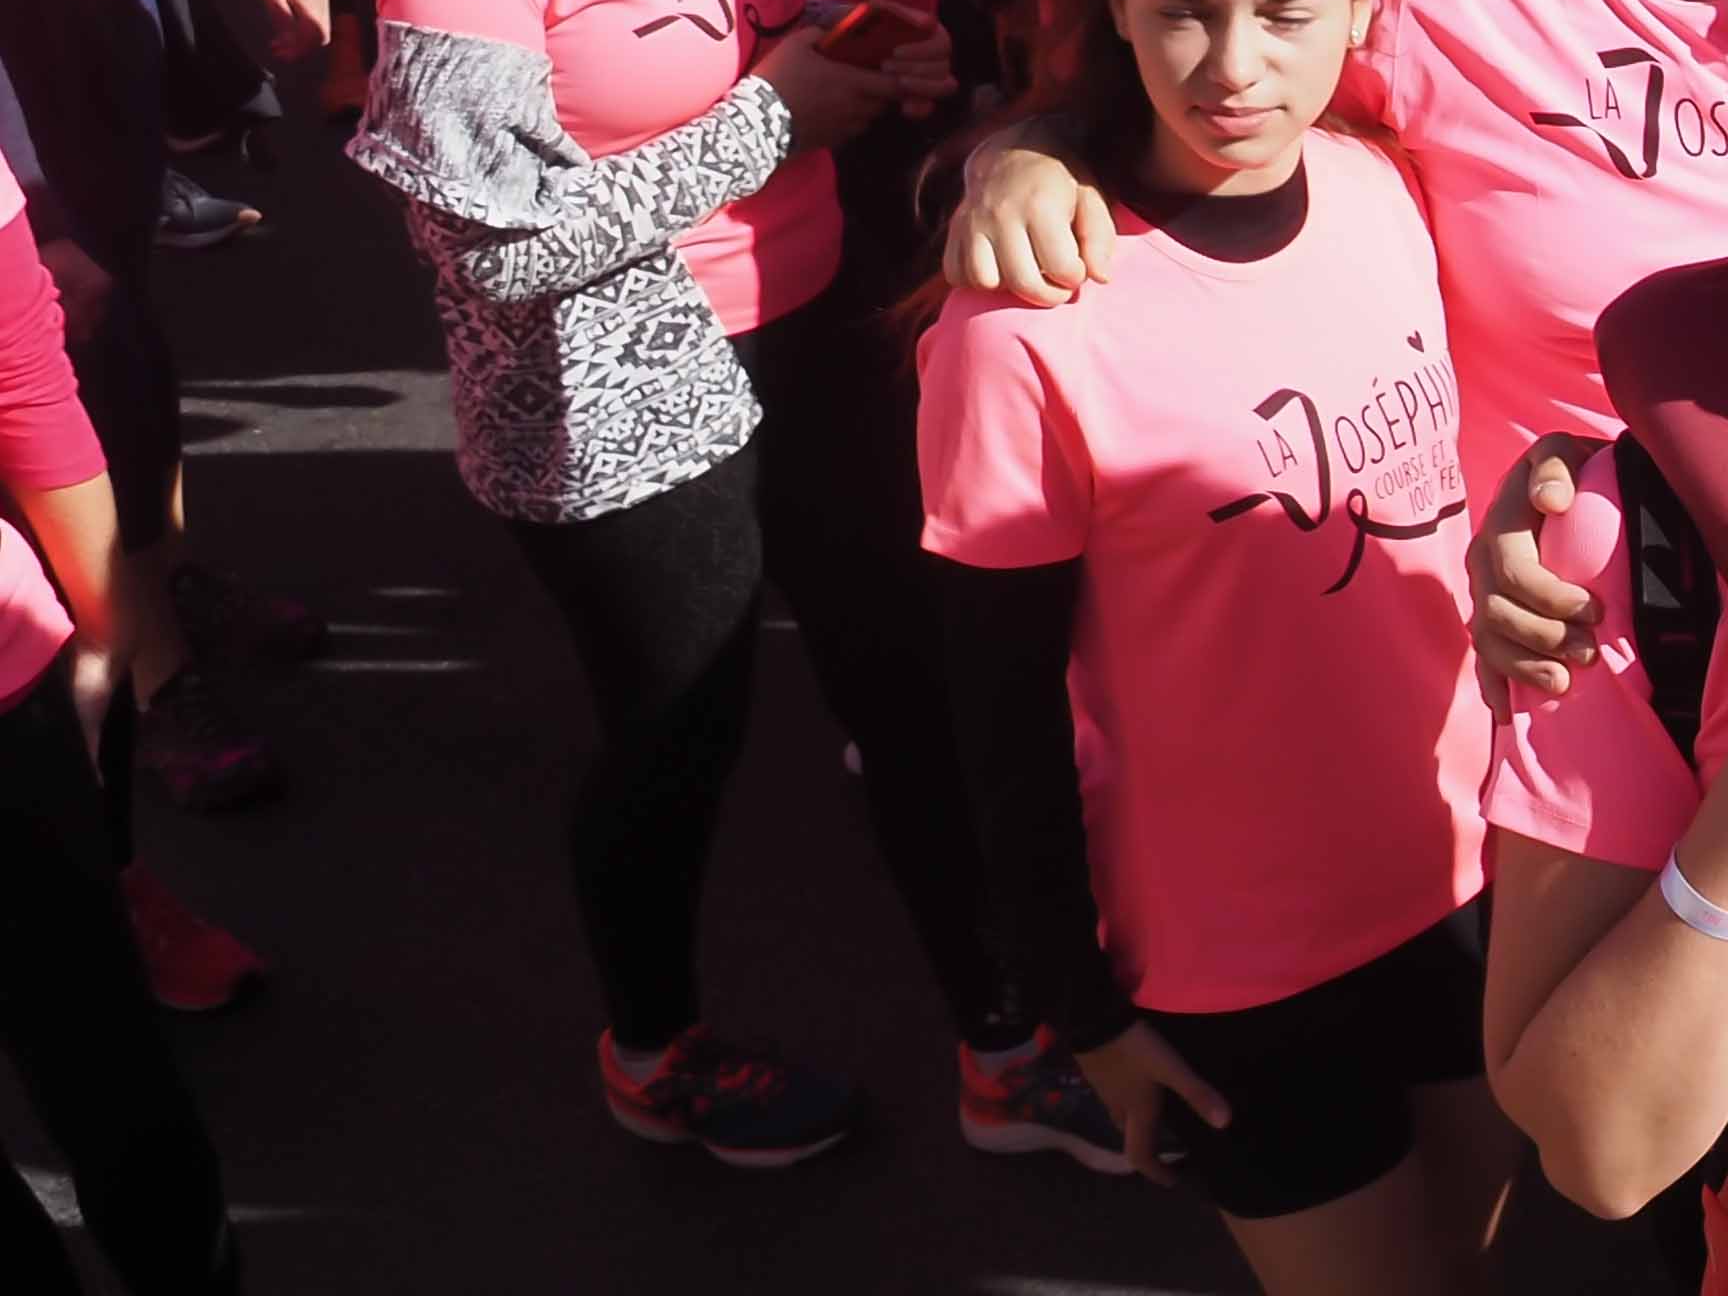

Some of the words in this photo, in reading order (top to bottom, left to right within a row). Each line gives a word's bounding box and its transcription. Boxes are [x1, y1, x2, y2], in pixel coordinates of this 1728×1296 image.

[1585, 76, 1622, 121] LA
[1256, 428, 1299, 478] LA
[1374, 453, 1427, 500] COURSE
[1431, 439, 1446, 468] ET
